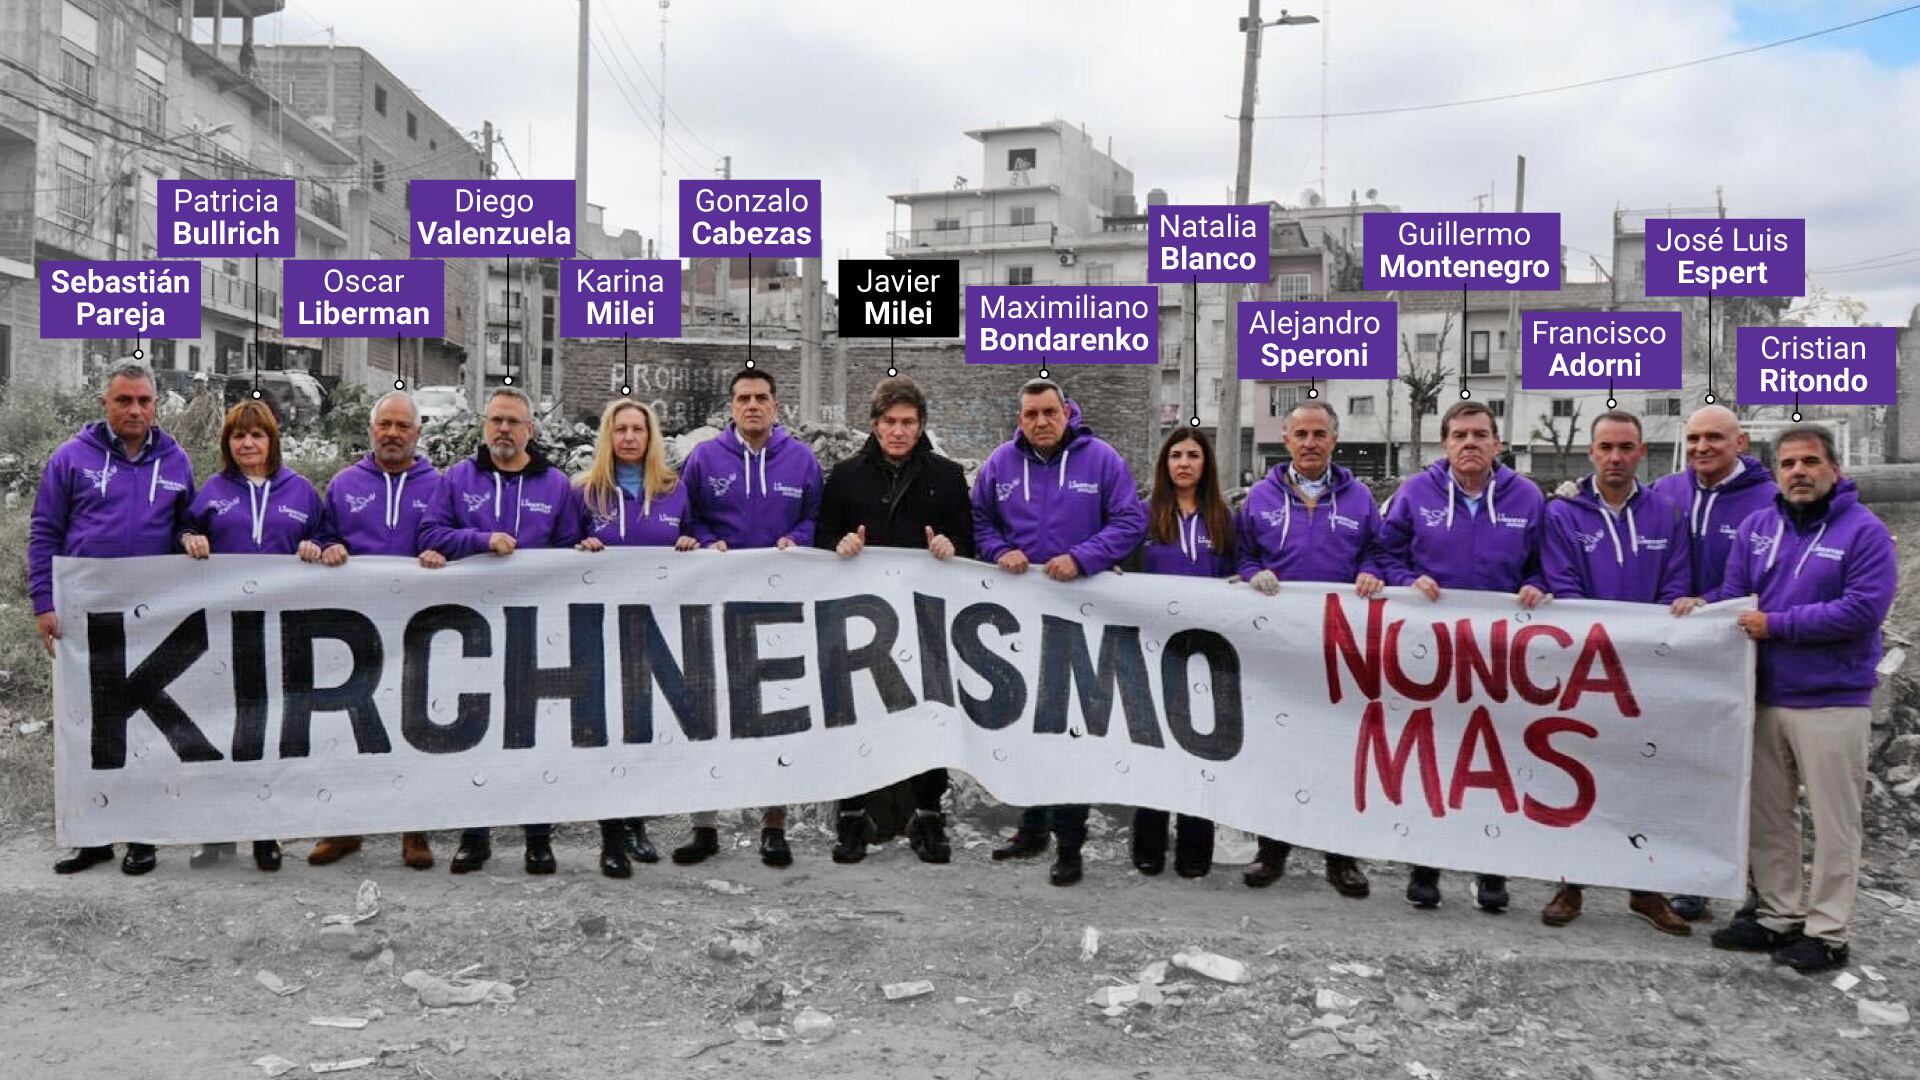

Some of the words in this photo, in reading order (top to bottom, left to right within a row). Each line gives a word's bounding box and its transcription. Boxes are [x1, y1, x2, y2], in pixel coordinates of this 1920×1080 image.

[86, 591, 1245, 771] KIRCHNERISMO
[1322, 592, 1641, 718] NUNCA
[1354, 701, 1598, 828] MAS
